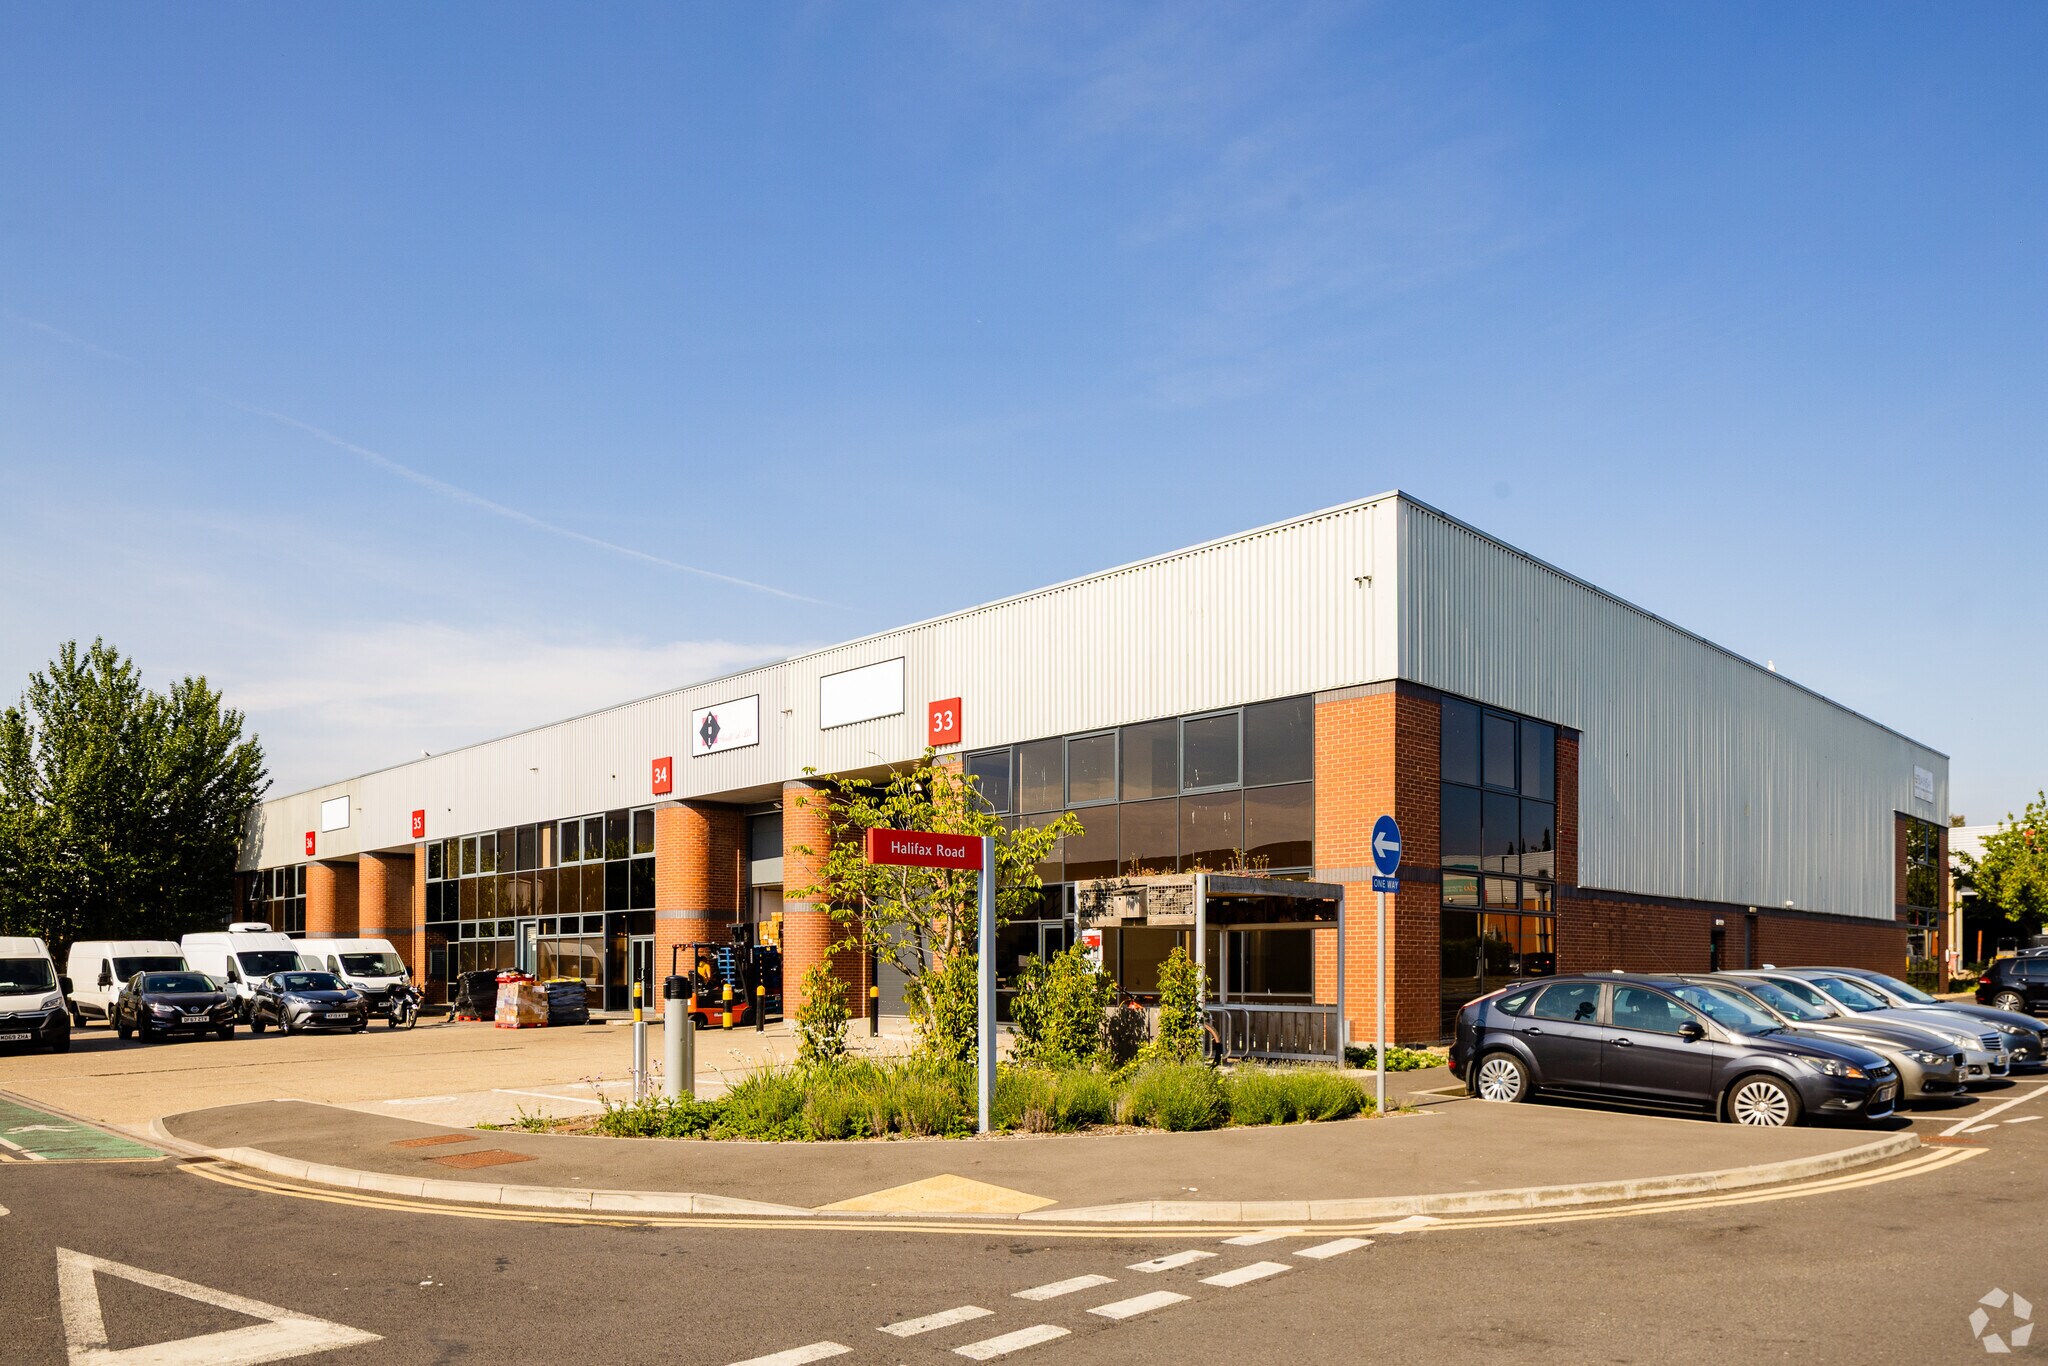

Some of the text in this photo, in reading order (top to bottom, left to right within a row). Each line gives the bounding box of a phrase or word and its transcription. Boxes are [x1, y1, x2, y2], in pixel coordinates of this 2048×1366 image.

[933, 710, 954, 733] 33
[654, 766, 667, 784] 34
[413, 816, 422, 830] 35
[306, 837, 313, 849] 36
[891, 841, 965, 858] Halifax Road
[1373, 878, 1399, 889] ONE WAY
